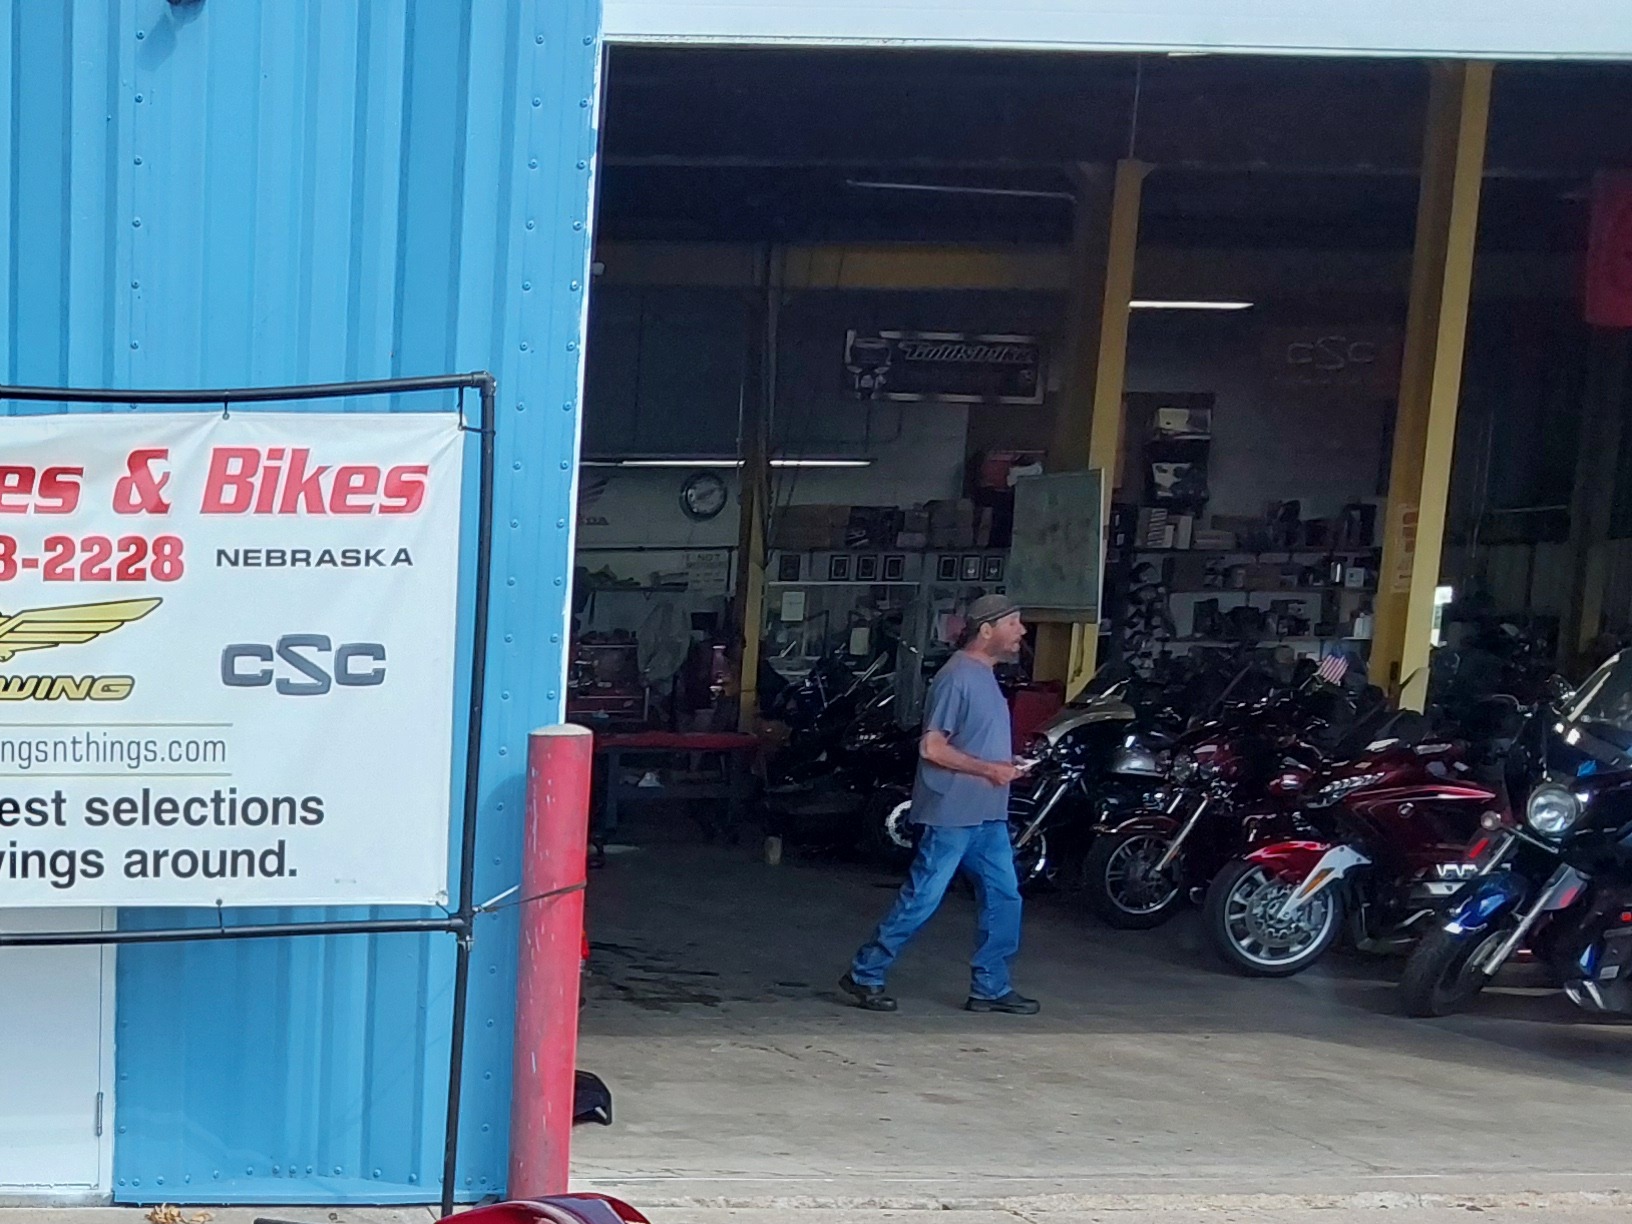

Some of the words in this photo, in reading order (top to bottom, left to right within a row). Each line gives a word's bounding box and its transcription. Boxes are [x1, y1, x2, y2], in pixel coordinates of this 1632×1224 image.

[112, 448, 171, 515] &
[199, 447, 429, 515] Bikes
[216, 547, 414, 568] NEBRASKA
[84, 787, 325, 827] selections
[123, 839, 297, 879] around.
